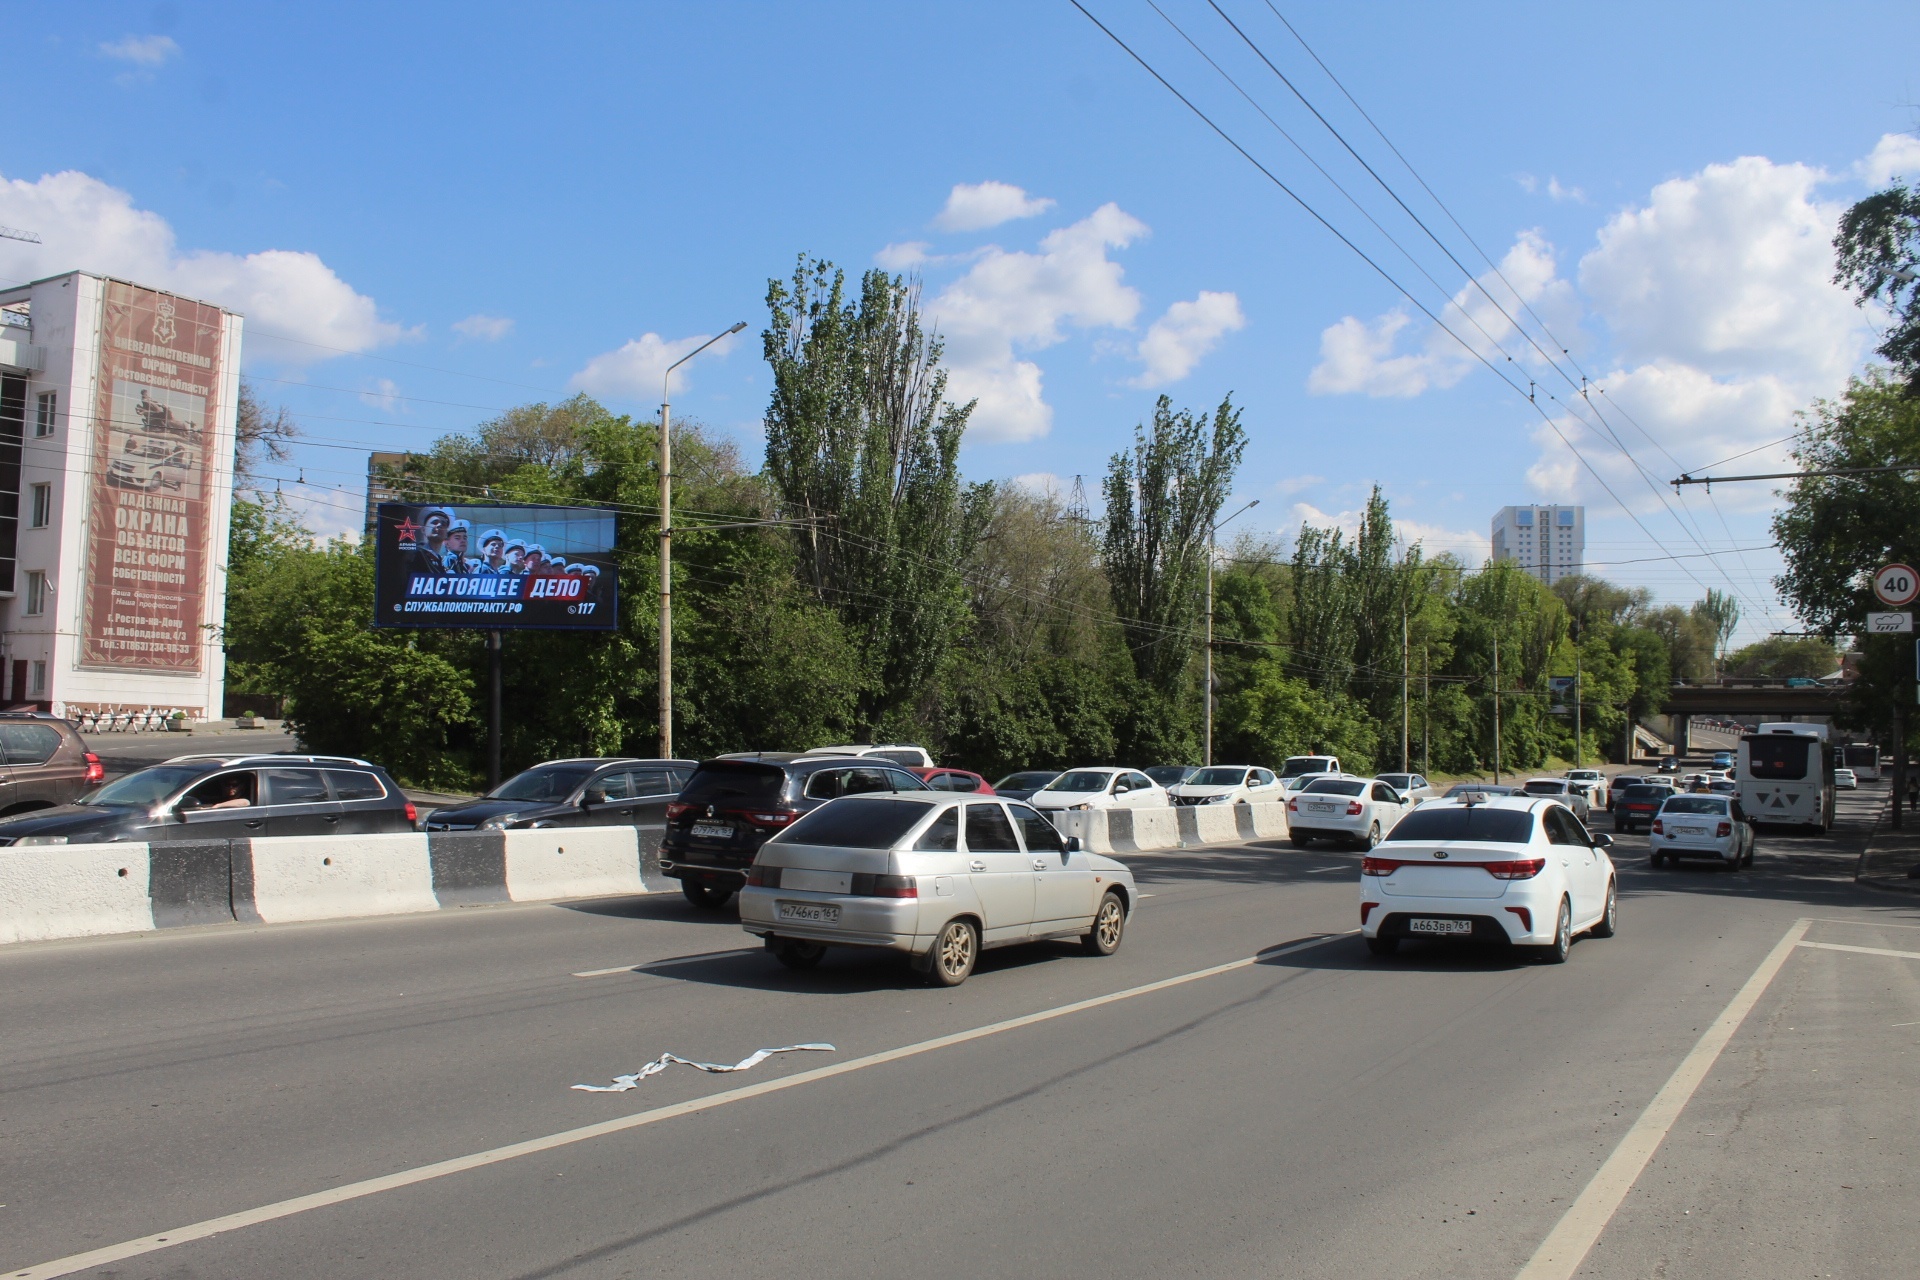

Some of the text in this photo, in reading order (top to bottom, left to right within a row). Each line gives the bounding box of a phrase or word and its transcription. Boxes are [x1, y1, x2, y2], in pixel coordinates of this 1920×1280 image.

[114, 336, 211, 368] ВНЕВЕДОМСТВЕННАЯ
[141, 357, 178, 375] ОХРАНА
[112, 364, 209, 395] Ростовской области
[120, 491, 187, 514] НАДЕЖНАЯ
[115, 507, 189, 536] ОХРАНА
[117, 530, 186, 552] ОБЪЕКТОВ
[114, 547, 186, 570] ВСЕХ ФОРМ
[112, 566, 186, 584] СОБСТВЕННОСТИ
[1884, 577, 1908, 592] 40
[410, 577, 582, 598] НАСТОЯЩЕЕ ДЕЛО
[404, 601, 596, 615] СЛУЖБАПОКОНТРАКТУ.РФ 117
[115, 613, 184, 628] Ростов-на-Дону
